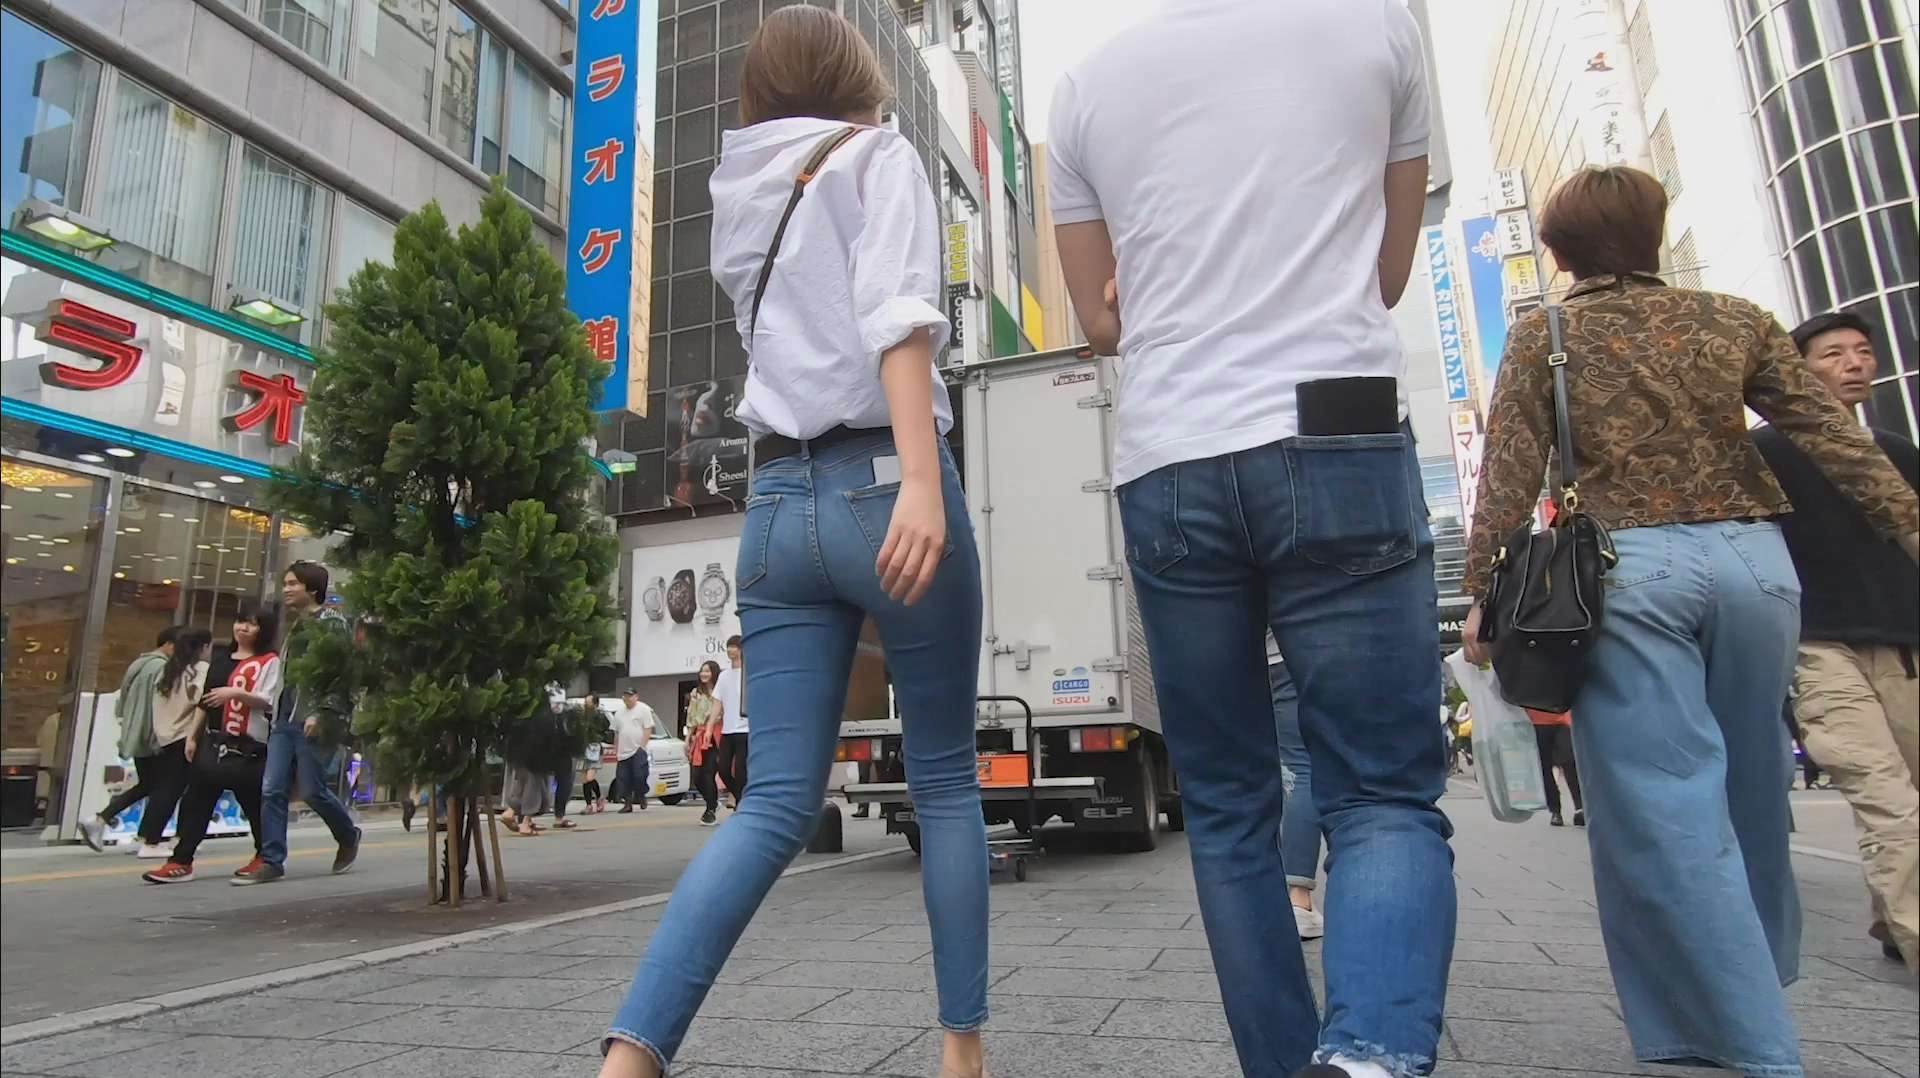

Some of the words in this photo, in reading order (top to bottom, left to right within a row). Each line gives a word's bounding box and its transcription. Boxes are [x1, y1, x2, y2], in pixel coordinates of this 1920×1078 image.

[706, 638, 727, 654] OK
[1053, 696, 1090, 704] ISUZU
[1083, 807, 1133, 818] ELF
